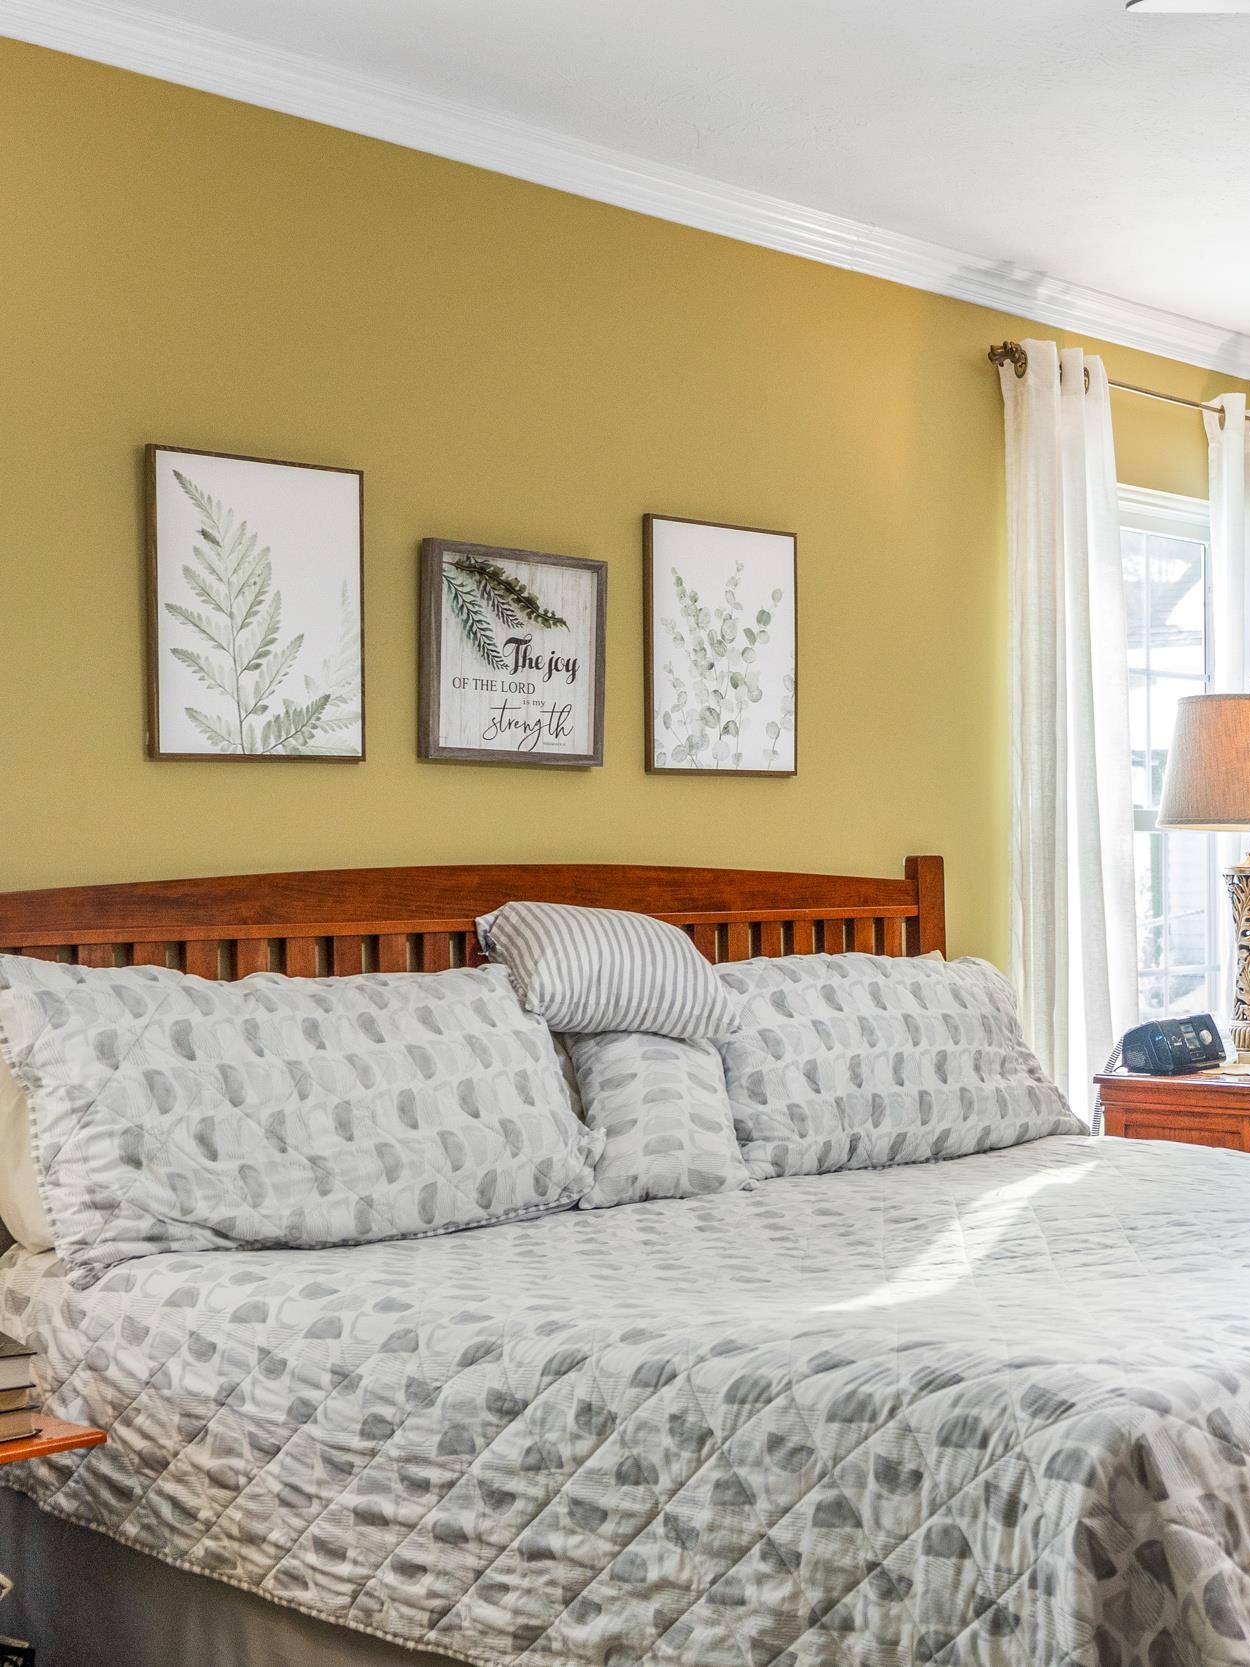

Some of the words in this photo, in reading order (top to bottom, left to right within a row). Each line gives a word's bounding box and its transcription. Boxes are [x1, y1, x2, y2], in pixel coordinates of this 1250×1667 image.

[503, 634, 545, 675] The
[543, 650, 580, 684] joy
[452, 677, 469, 689] OF
[473, 678, 497, 692] THE
[501, 681, 536, 695] LORD
[532, 700, 546, 708] my
[482, 698, 575, 752] strength
